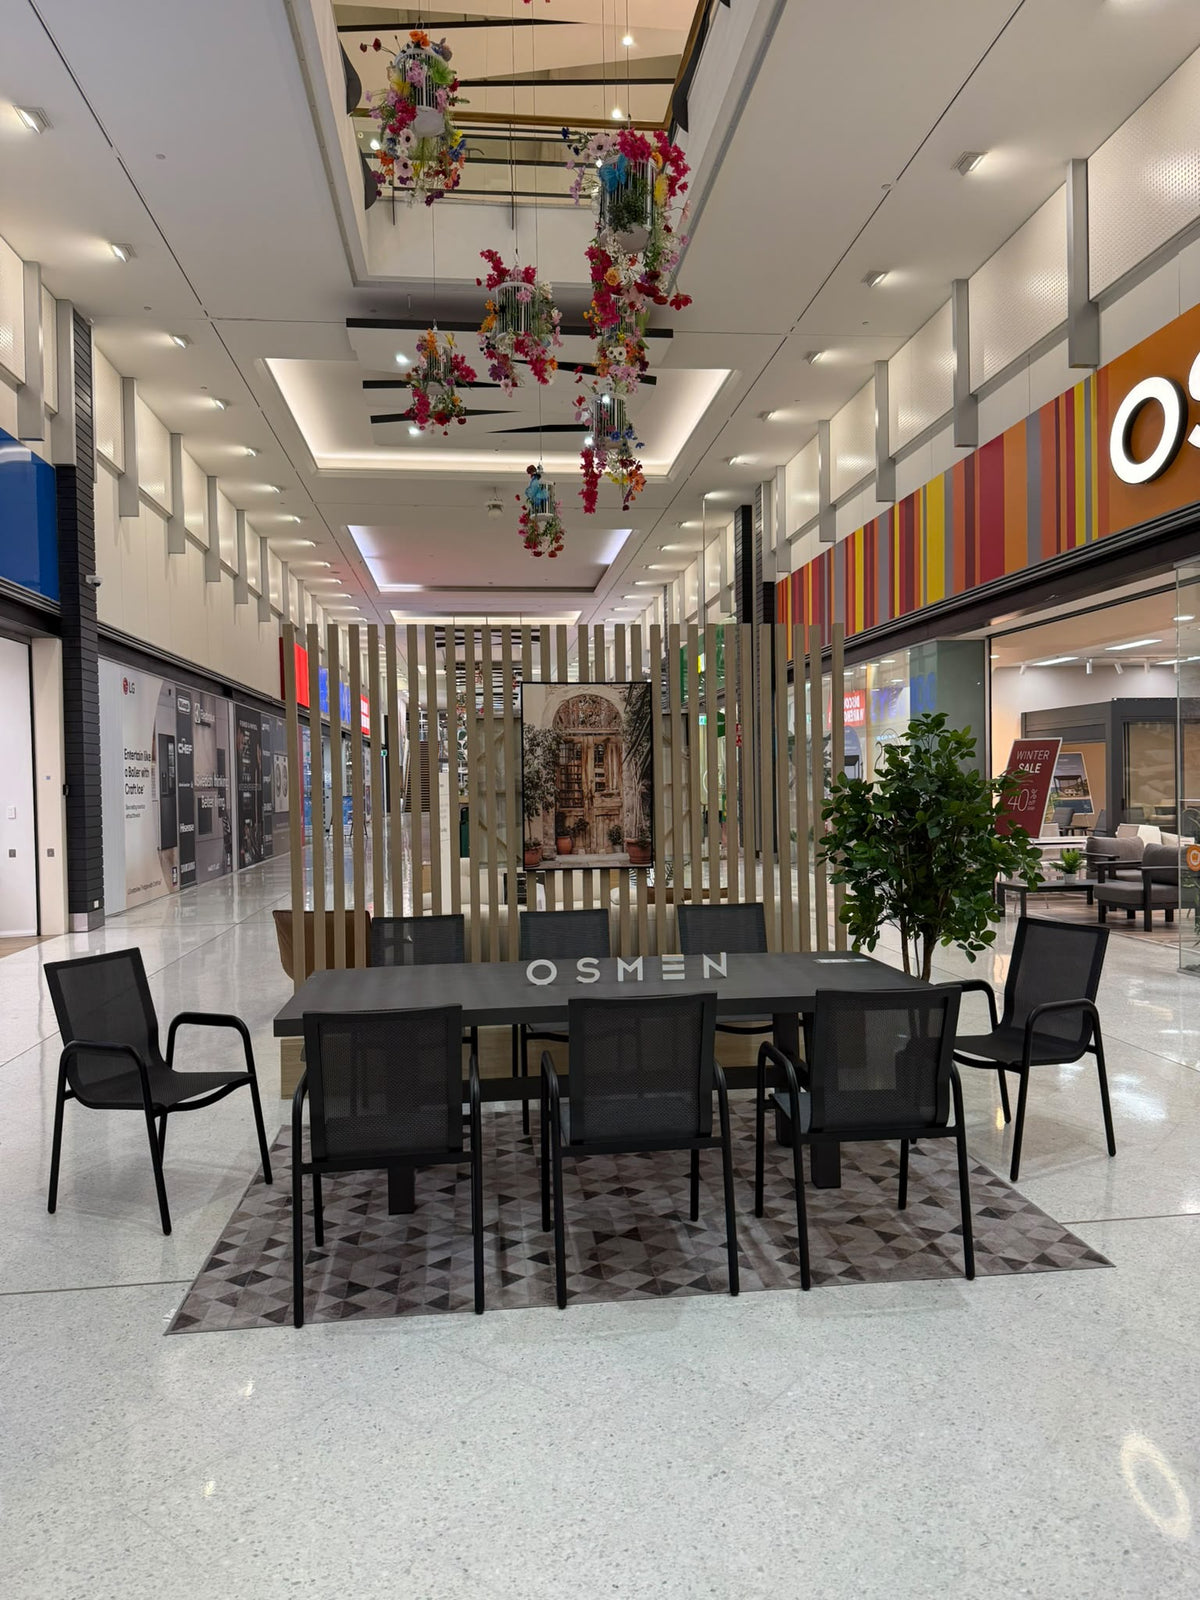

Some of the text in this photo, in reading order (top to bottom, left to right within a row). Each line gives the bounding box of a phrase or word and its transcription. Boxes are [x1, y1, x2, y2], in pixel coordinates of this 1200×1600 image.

[124, 748, 152, 762] Entertain like
[1016, 750, 1050, 760] WINTER
[141, 767, 150, 778] with
[1018, 763, 1042, 774] SALE
[125, 783, 136, 796] Craft
[526, 952, 727, 986] OSMEN
